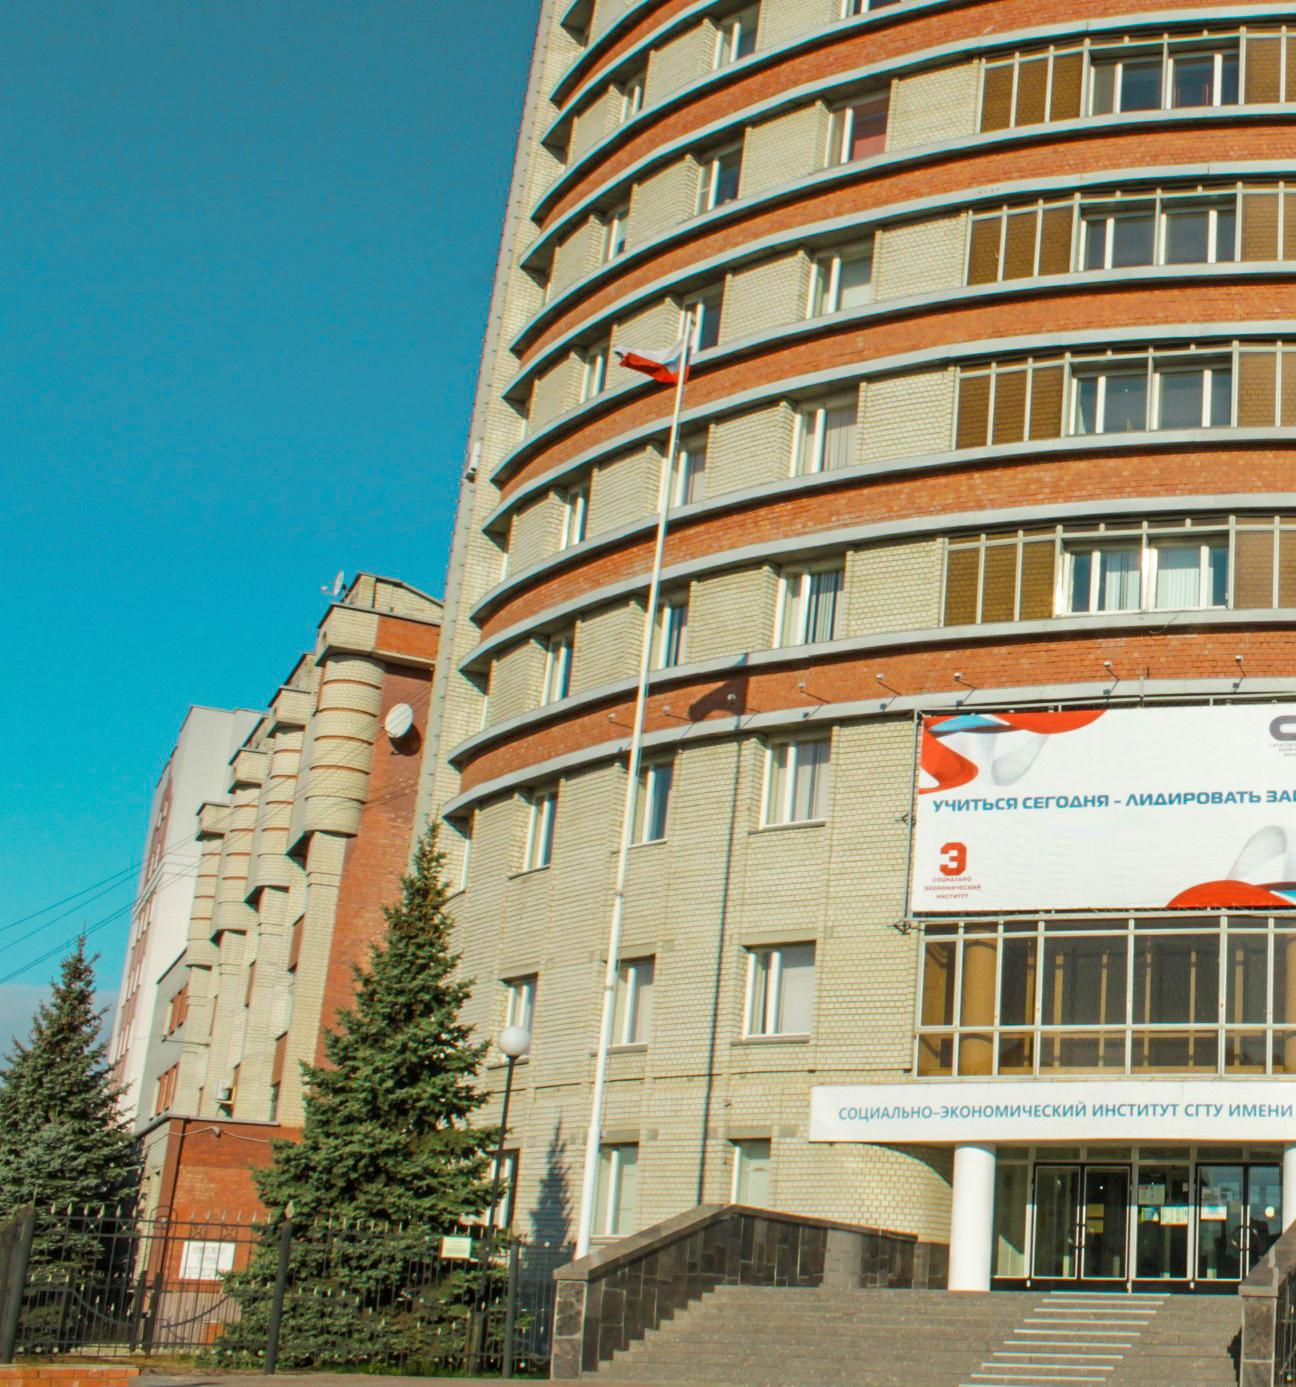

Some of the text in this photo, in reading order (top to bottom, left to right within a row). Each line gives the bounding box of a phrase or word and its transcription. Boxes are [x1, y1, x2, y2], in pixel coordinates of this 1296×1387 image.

[932, 797, 1018, 813] УЧИТЬСЯ
[1023, 794, 1110, 810] СЕГОДНЯ
[1125, 791, 1261, 807] ЛИДИРОВАТЬ
[1092, 1103, 1180, 1118] ИНСТИТУТ
[1184, 1103, 1224, 1118] СГТУ
[1228, 1103, 1294, 1118] ИМЕНИ
